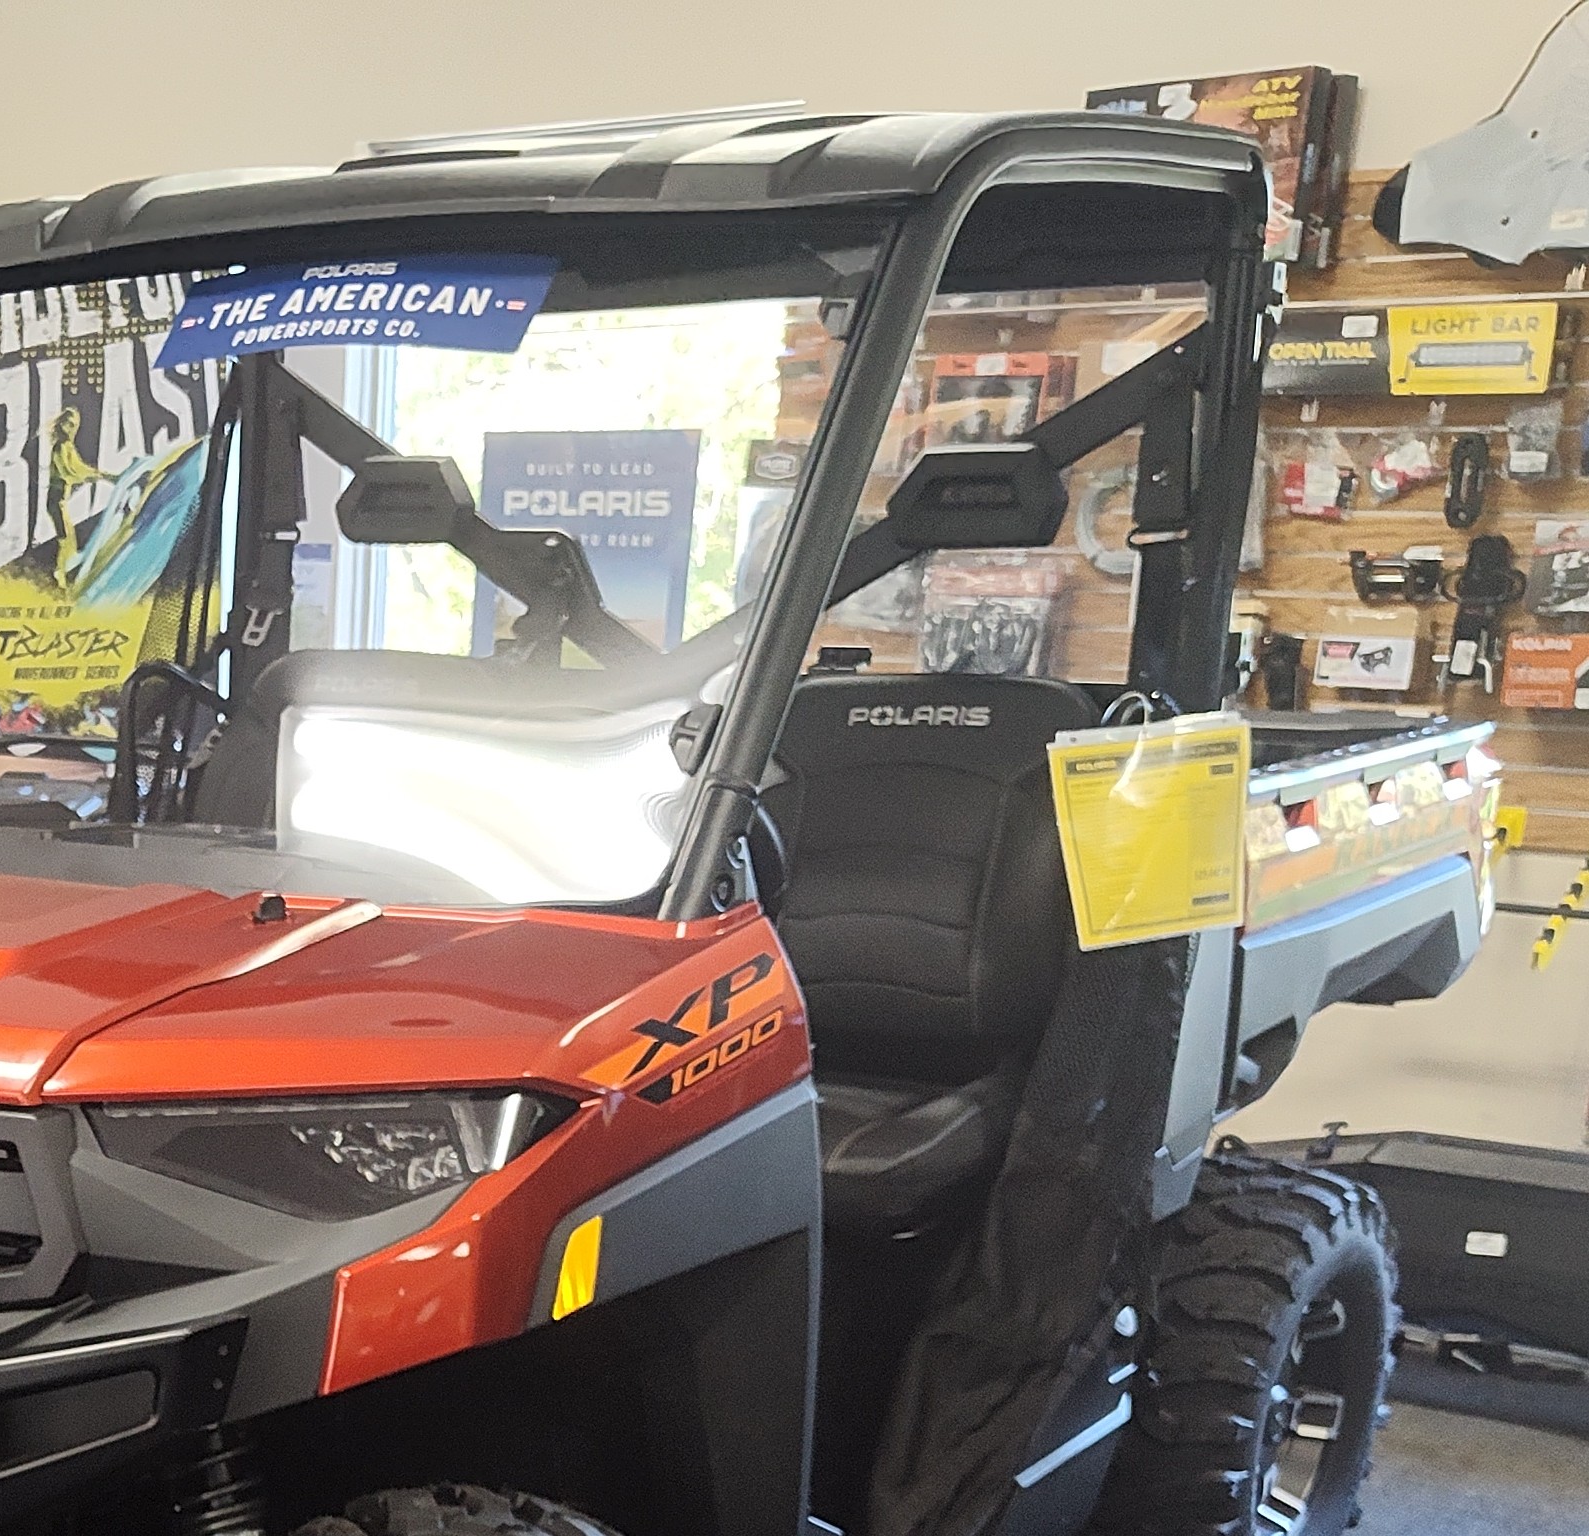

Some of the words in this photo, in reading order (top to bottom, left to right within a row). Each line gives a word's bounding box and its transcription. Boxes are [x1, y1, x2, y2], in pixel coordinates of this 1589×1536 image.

[302, 262, 399, 282] POLARIS
[208, 294, 276, 331] THE
[279, 282, 493, 317] AMERICAN
[231, 318, 378, 347] POWERSPORTS
[382, 319, 421, 338] CO.
[1411, 316, 1481, 335] LIGHT
[1491, 315, 1541, 333] BAR
[526, 462, 574, 476] BUILT
[582, 462, 604, 476] TO
[502, 489, 673, 518] POLARIS
[847, 704, 992, 728] POLARIS
[623, 952, 775, 1082] XP
[670, 1010, 781, 1095] 1000
